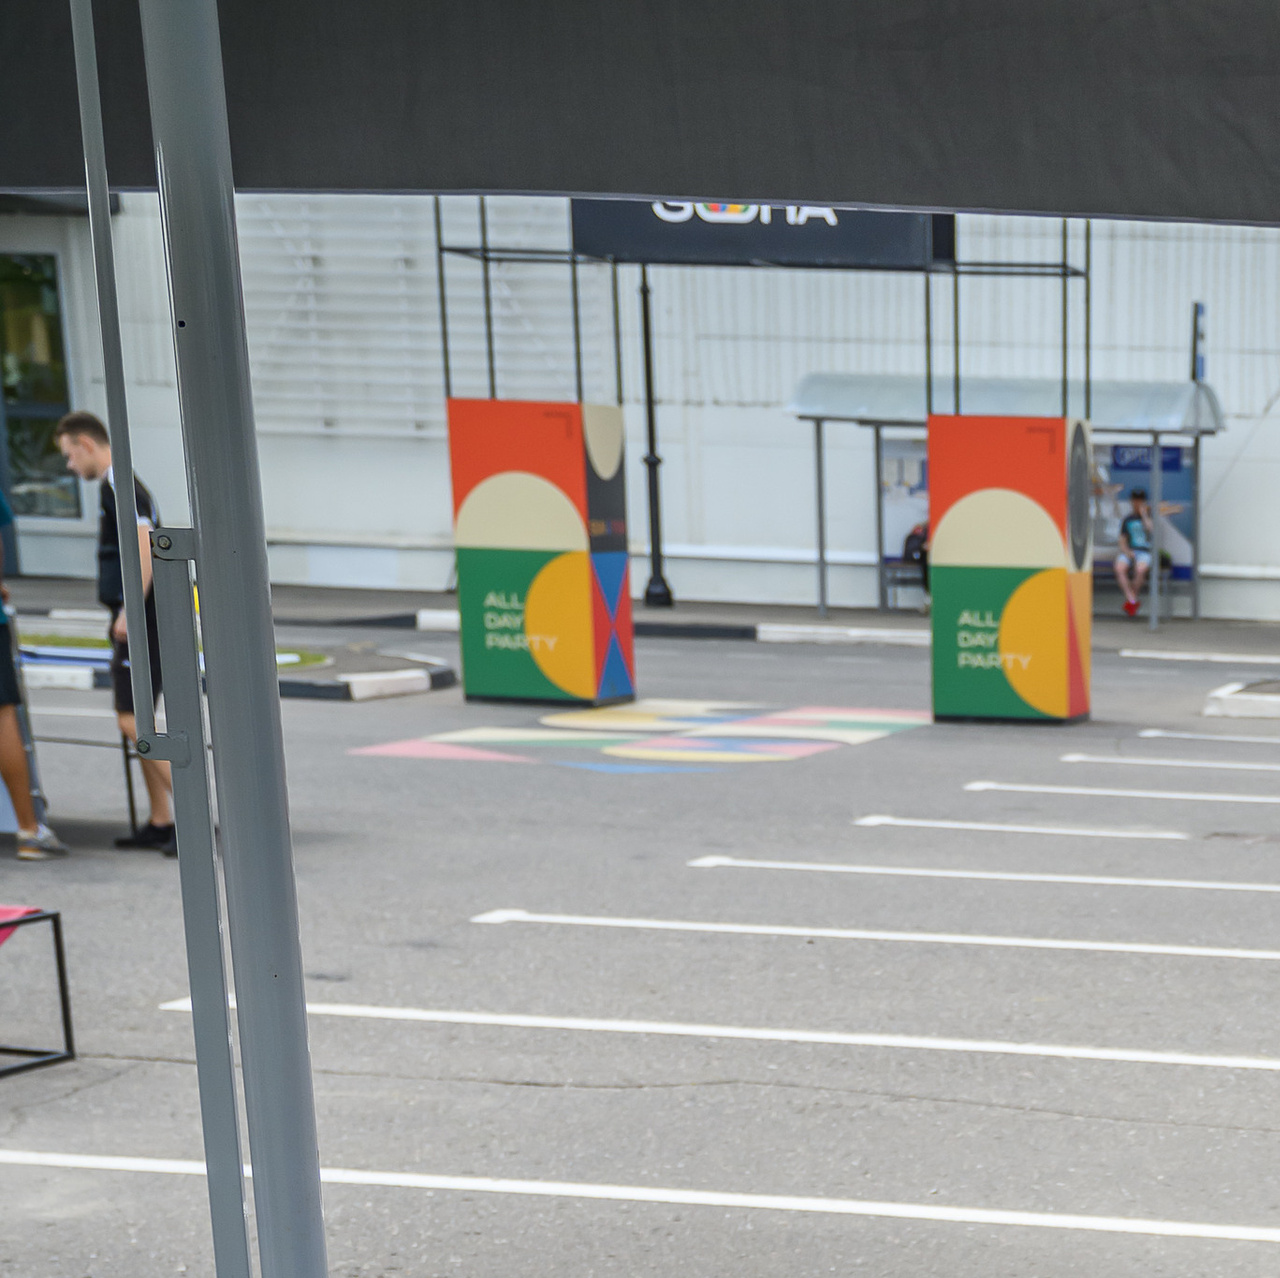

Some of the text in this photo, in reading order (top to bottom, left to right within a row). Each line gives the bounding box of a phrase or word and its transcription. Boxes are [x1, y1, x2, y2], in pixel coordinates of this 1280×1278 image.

[484, 592, 525, 610] ALL
[484, 611, 524, 630] DAY
[958, 610, 999, 628] ALL
[485, 631, 558, 652] PARTY
[957, 631, 998, 648] DAY
[958, 652, 1032, 670] PARTY
